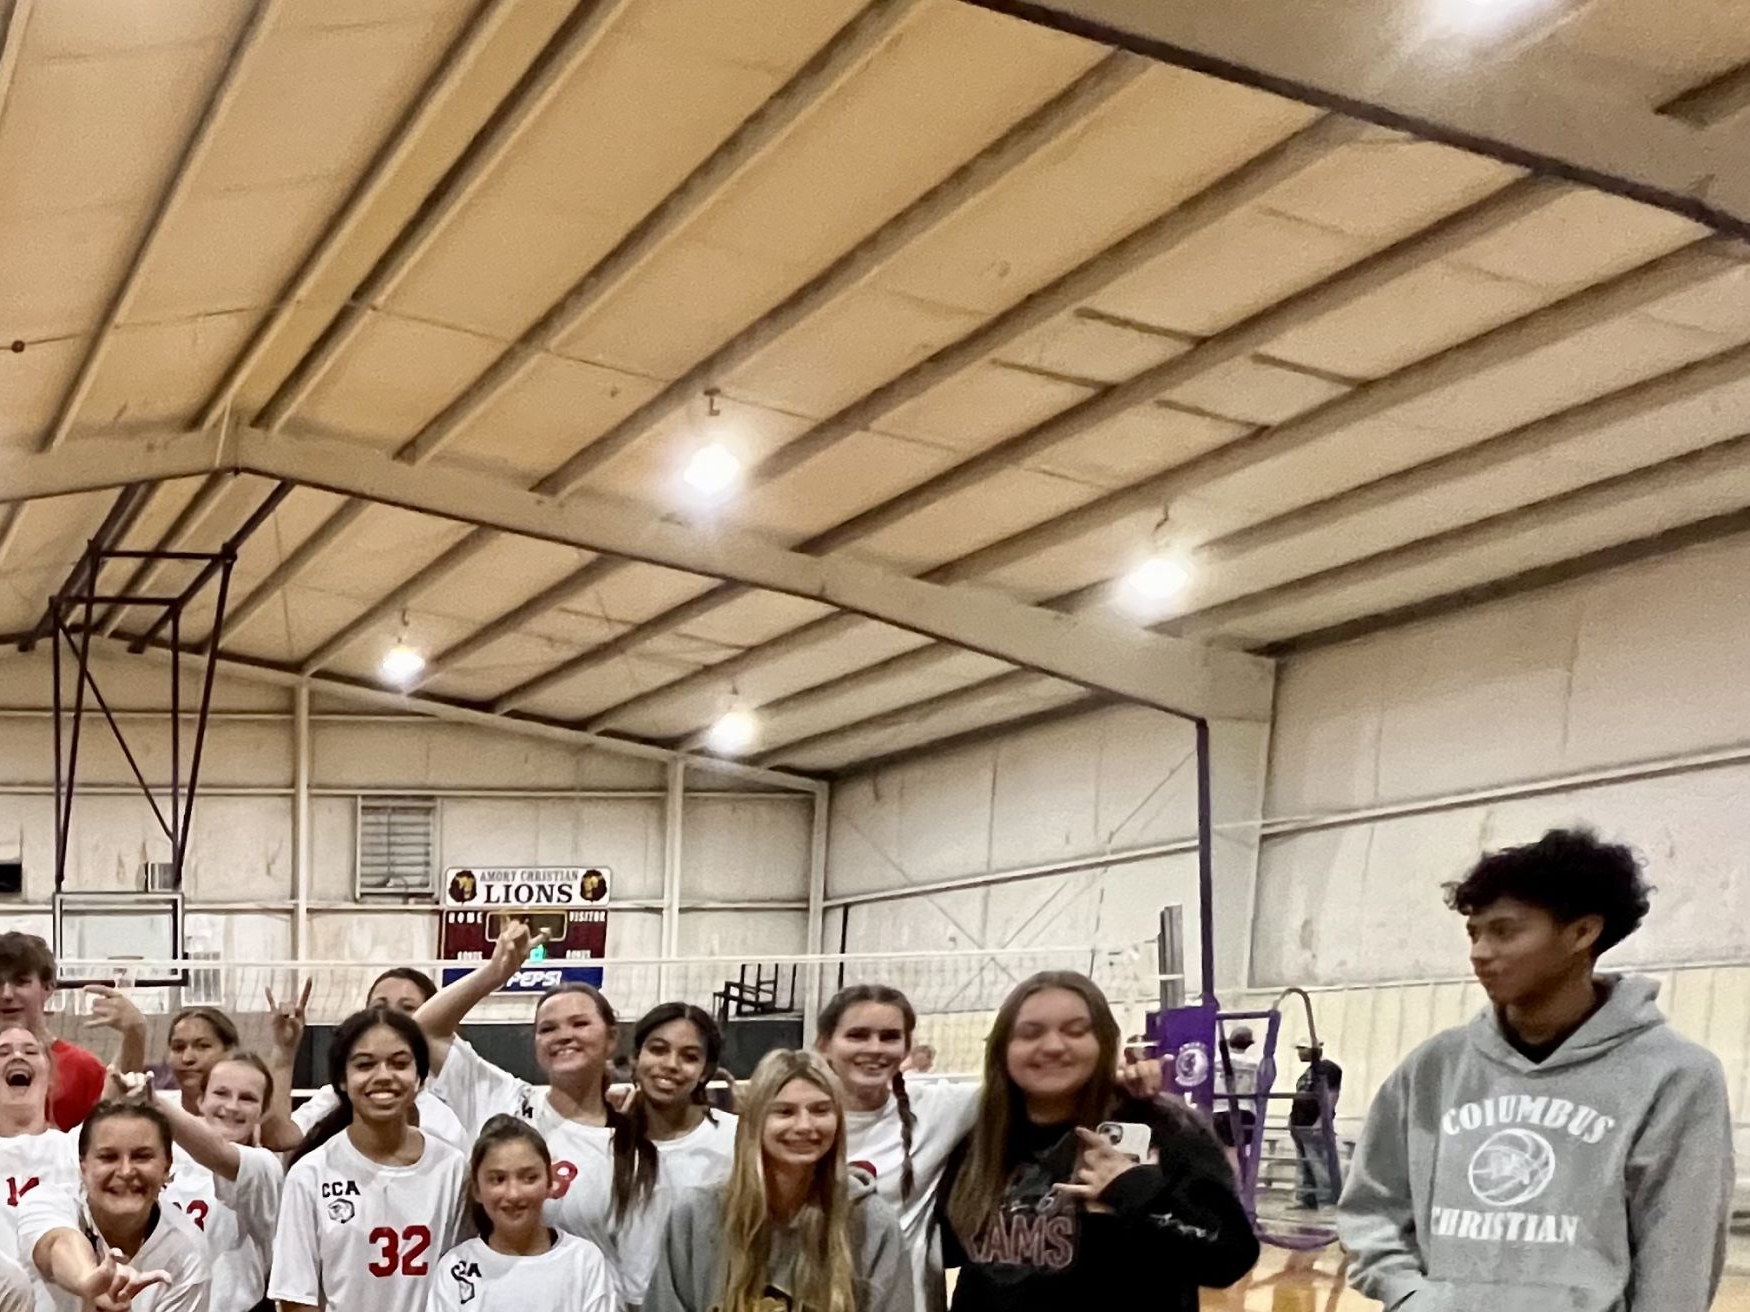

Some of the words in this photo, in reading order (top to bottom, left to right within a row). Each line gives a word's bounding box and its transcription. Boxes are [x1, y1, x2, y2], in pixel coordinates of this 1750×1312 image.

[480, 871, 517, 882] AMORY
[520, 870, 579, 882] CHRISTIAN
[483, 884, 573, 904] LIONS
[448, 912, 483, 924] HOME
[569, 911, 606, 922] VISITOR
[506, 970, 562, 988] PEPSI
[322, 1180, 361, 1198] CCA
[369, 1225, 431, 1278] 32
